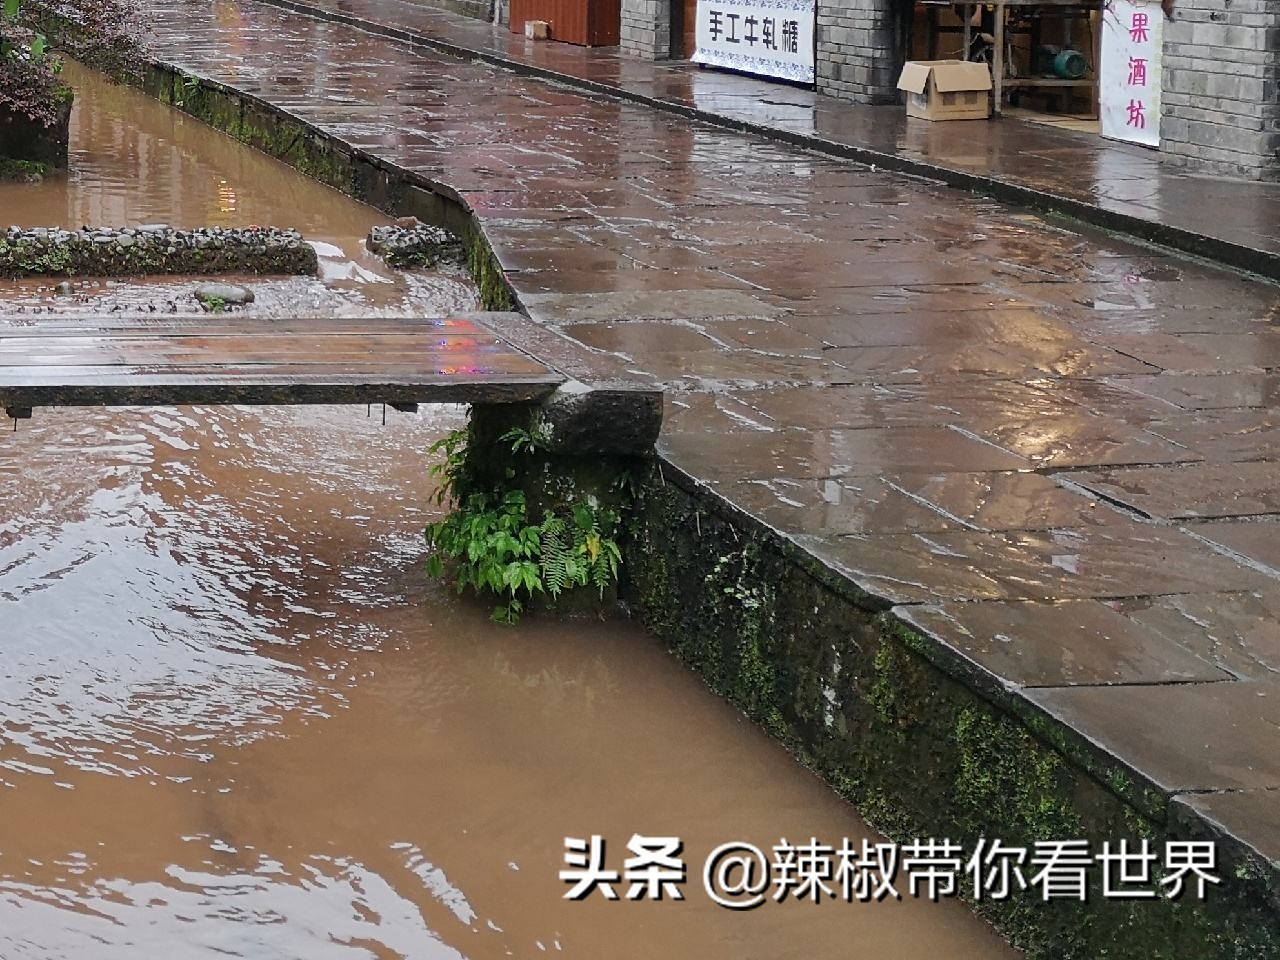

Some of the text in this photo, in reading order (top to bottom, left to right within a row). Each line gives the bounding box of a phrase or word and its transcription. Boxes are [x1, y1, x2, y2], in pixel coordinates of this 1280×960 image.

[708, 10, 799, 54] 手工牛轧糖
[1125, 12, 1151, 130] 果酒坊
